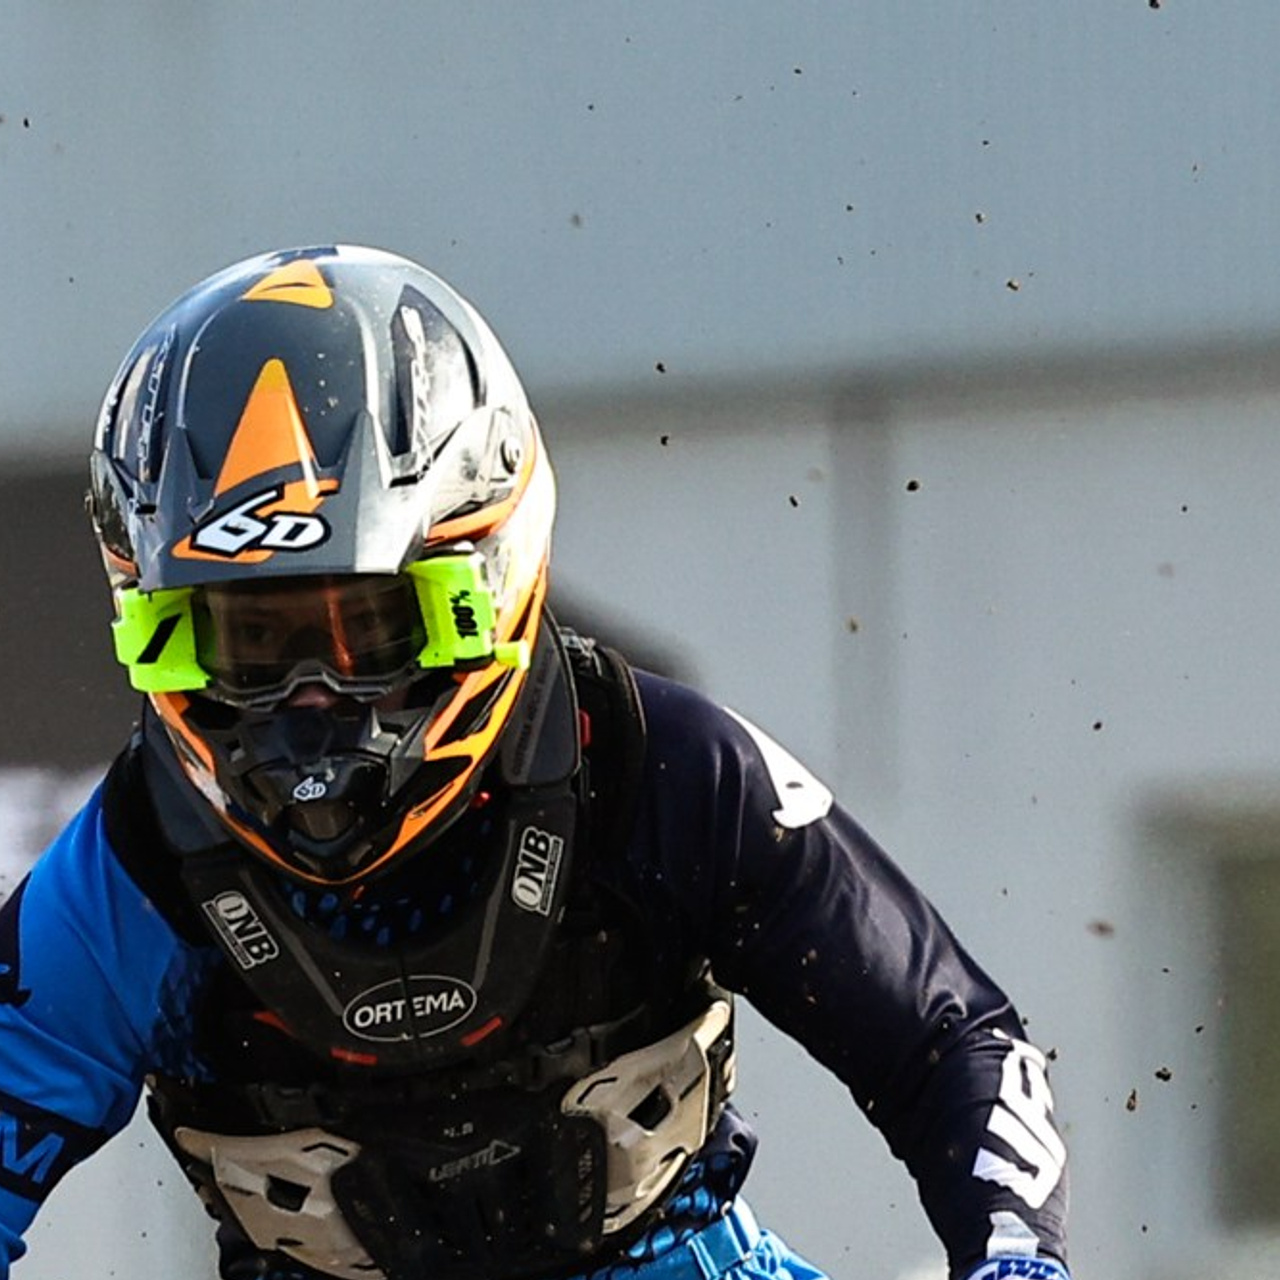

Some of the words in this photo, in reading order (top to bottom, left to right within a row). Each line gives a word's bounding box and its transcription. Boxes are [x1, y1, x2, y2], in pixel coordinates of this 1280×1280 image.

[195, 488, 326, 553] 6D
[448, 589, 480, 639] 100%
[354, 989, 466, 1028] ORTEMA
